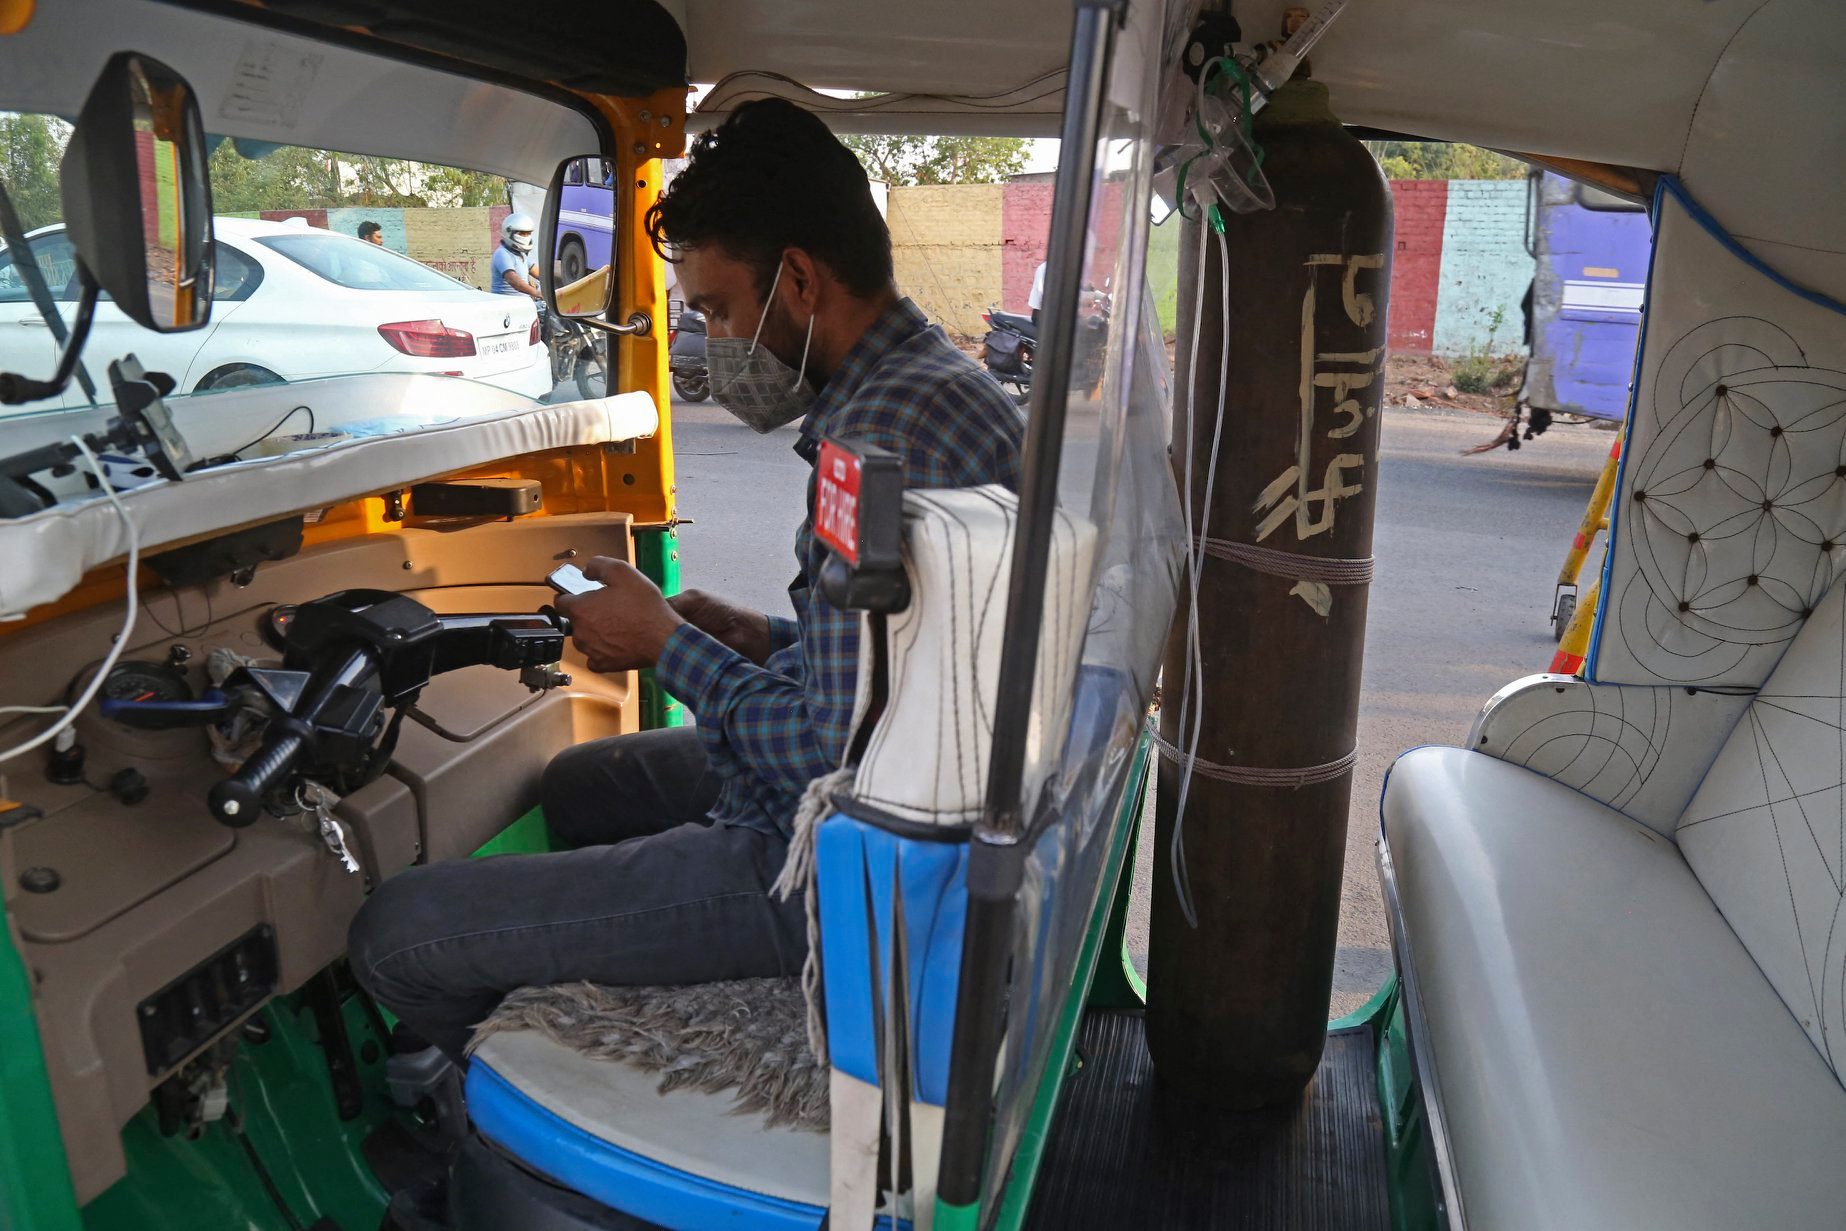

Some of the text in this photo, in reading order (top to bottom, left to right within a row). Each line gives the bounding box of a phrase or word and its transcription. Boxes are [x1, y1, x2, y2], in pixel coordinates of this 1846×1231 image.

[499, 343, 508, 353] CM
[819, 478, 856, 551] FOR HIRE
